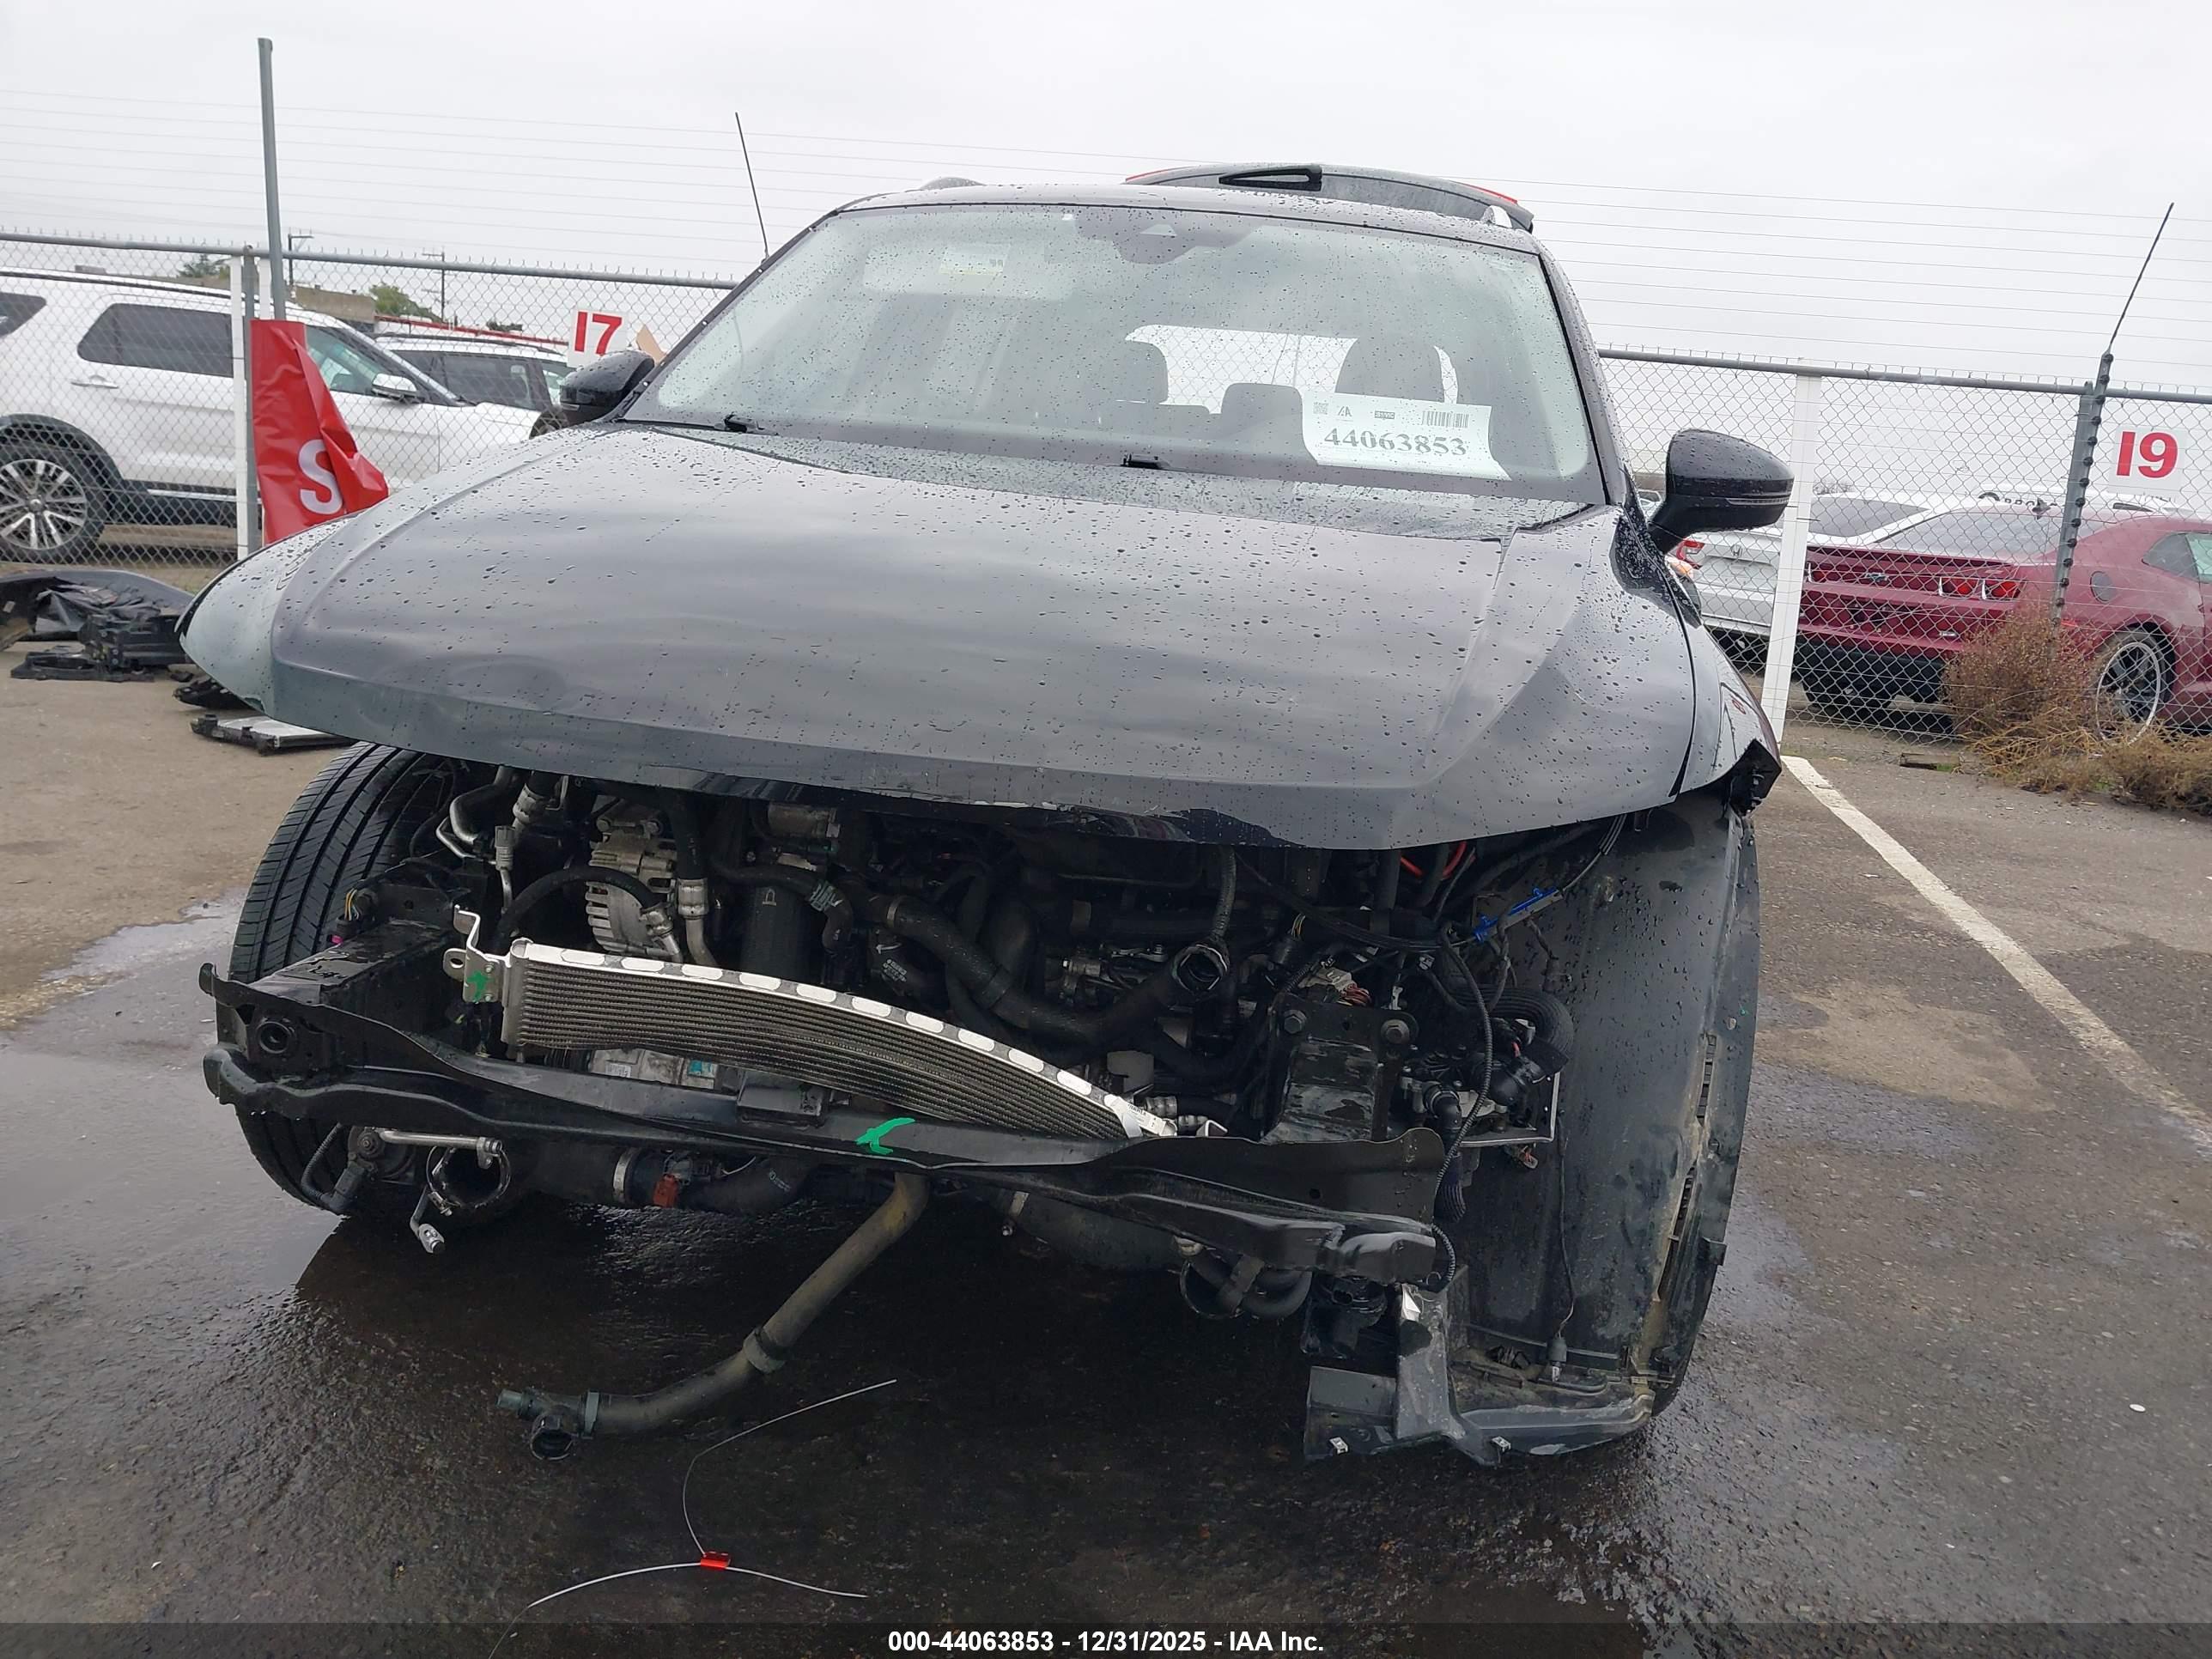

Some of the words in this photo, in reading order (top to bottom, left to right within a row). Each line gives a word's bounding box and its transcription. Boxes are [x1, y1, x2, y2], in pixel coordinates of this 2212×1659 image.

[574, 312, 622, 356] 17
[1324, 428, 1467, 455] 44063853
[2116, 431, 2179, 478] 19
